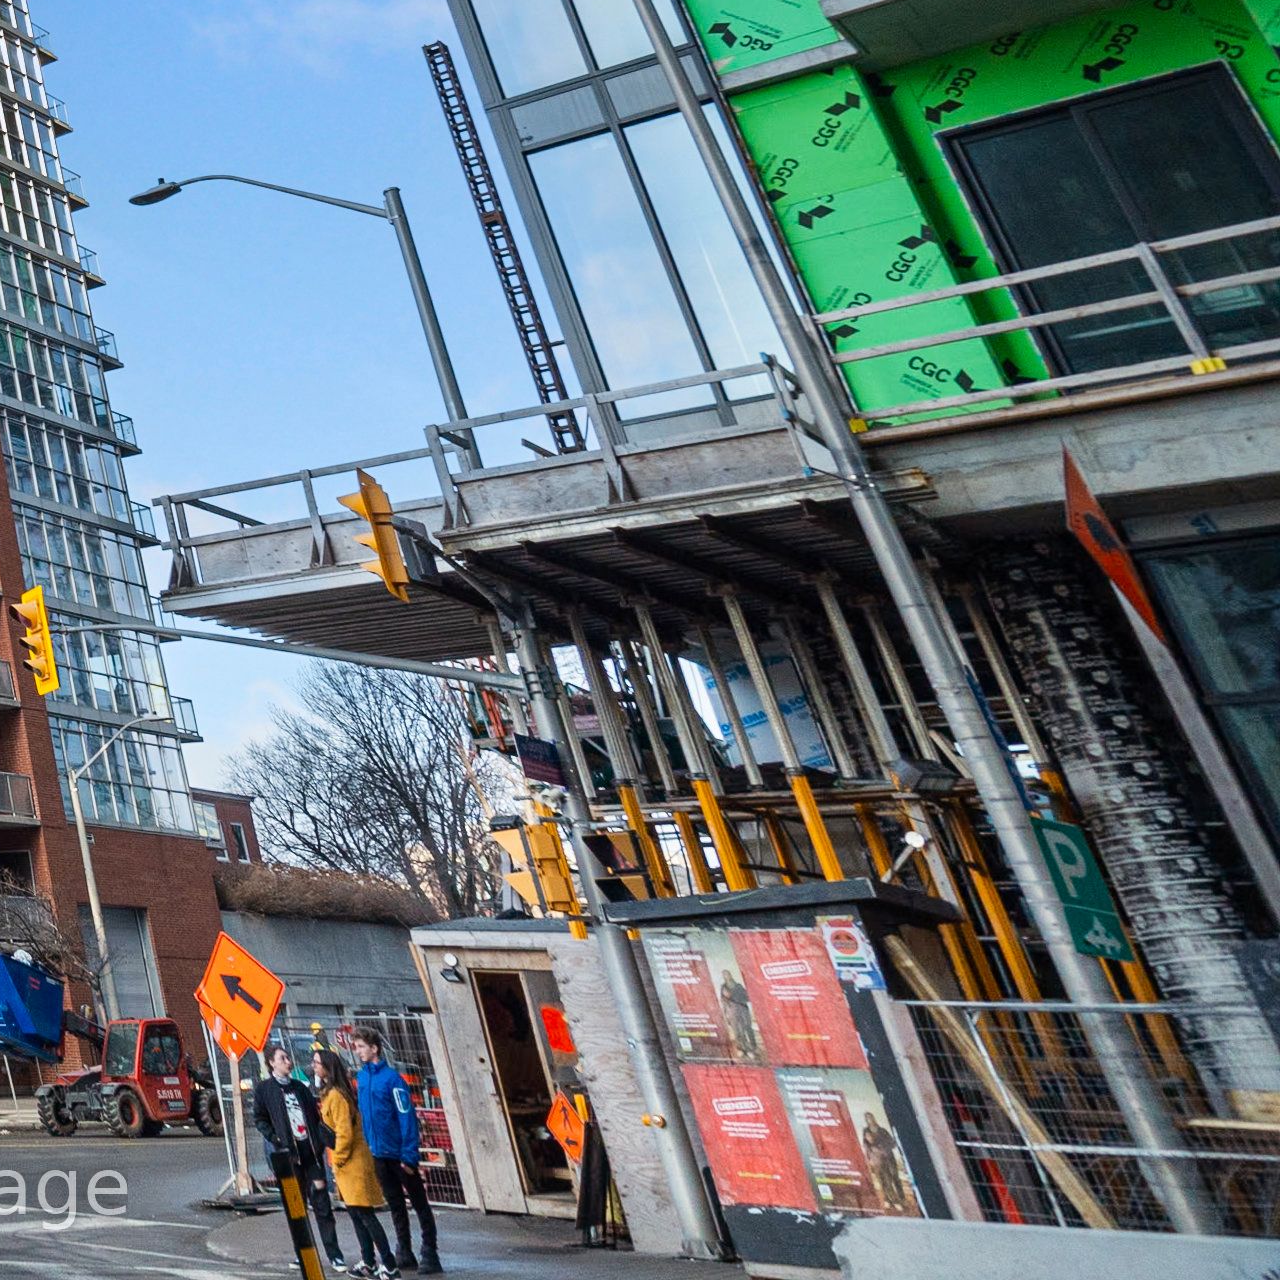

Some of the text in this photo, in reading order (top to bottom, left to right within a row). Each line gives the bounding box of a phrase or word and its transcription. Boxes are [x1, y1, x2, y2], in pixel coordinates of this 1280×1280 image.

[1103, 23, 1139, 55] CGC
[944, 67, 977, 98] CGC
[811, 118, 842, 148] CGC
[770, 157, 799, 188] CGC
[885, 251, 917, 282] CGC
[907, 355, 952, 383] CGC
[1042, 827, 1087, 898] P
